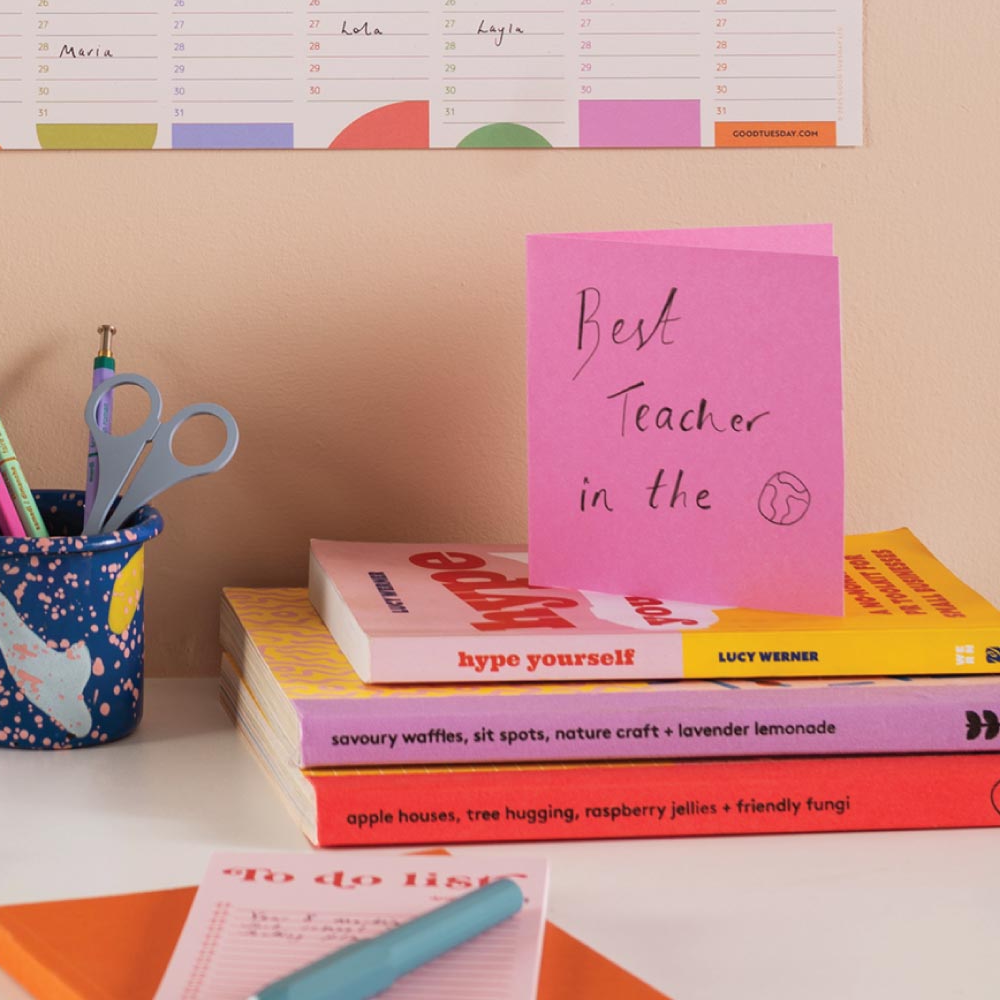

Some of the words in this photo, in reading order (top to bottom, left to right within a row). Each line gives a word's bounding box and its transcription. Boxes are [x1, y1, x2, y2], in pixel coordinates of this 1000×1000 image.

[309, 19, 321, 29] 27
[341, 21, 383, 36] Lola
[444, 19, 456, 29] 27
[477, 19, 524, 47] Layla
[37, 42, 50, 52] 28
[59, 44, 113, 59] Maria
[38, 108, 48, 117] 31
[174, 108, 184, 117] 31
[445, 107, 455, 117] 31
[716, 106, 727, 116] 31
[732, 129, 819, 138] GOODTUESDAY.COM
[573, 288, 680, 381] Best
[607, 381, 769, 436] Teacher
[581, 477, 613, 511] in
[647, 469, 711, 510] the
[844, 554, 876, 570] FOR
[871, 549, 936, 593] BUSINESSES
[409, 552, 579, 631] hype
[860, 572, 914, 604] TOOLKIT
[900, 605, 928, 615] PR
[921, 594, 966, 618] SMALL
[458, 652, 520, 672] hype
[527, 649, 635, 672] yourself
[719, 652, 755, 662] LUCY
[759, 652, 818, 662] WERNER
[332, 734, 397, 748] savoury
[402, 729, 468, 744] waffles,
[474, 727, 494, 742] sit
[500, 729, 549, 745] spots,
[556, 728, 611, 740] nature
[616, 724, 659, 738] craft
[664, 727, 673, 736] +
[679, 723, 749, 737] lavender
[755, 720, 835, 735] lemonade
[347, 810, 393, 828] apple
[399, 809, 460, 823] houses,
[467, 809, 500, 821] tree
[506, 804, 579, 824] hugging,
[585, 804, 666, 821] raspberry
[671, 801, 717, 820] jellies
[723, 804, 730, 812] +
[736, 798, 801, 815] friendly
[806, 796, 849, 815] fungi
[222, 868, 295, 882] To
[314, 871, 382, 889] do
